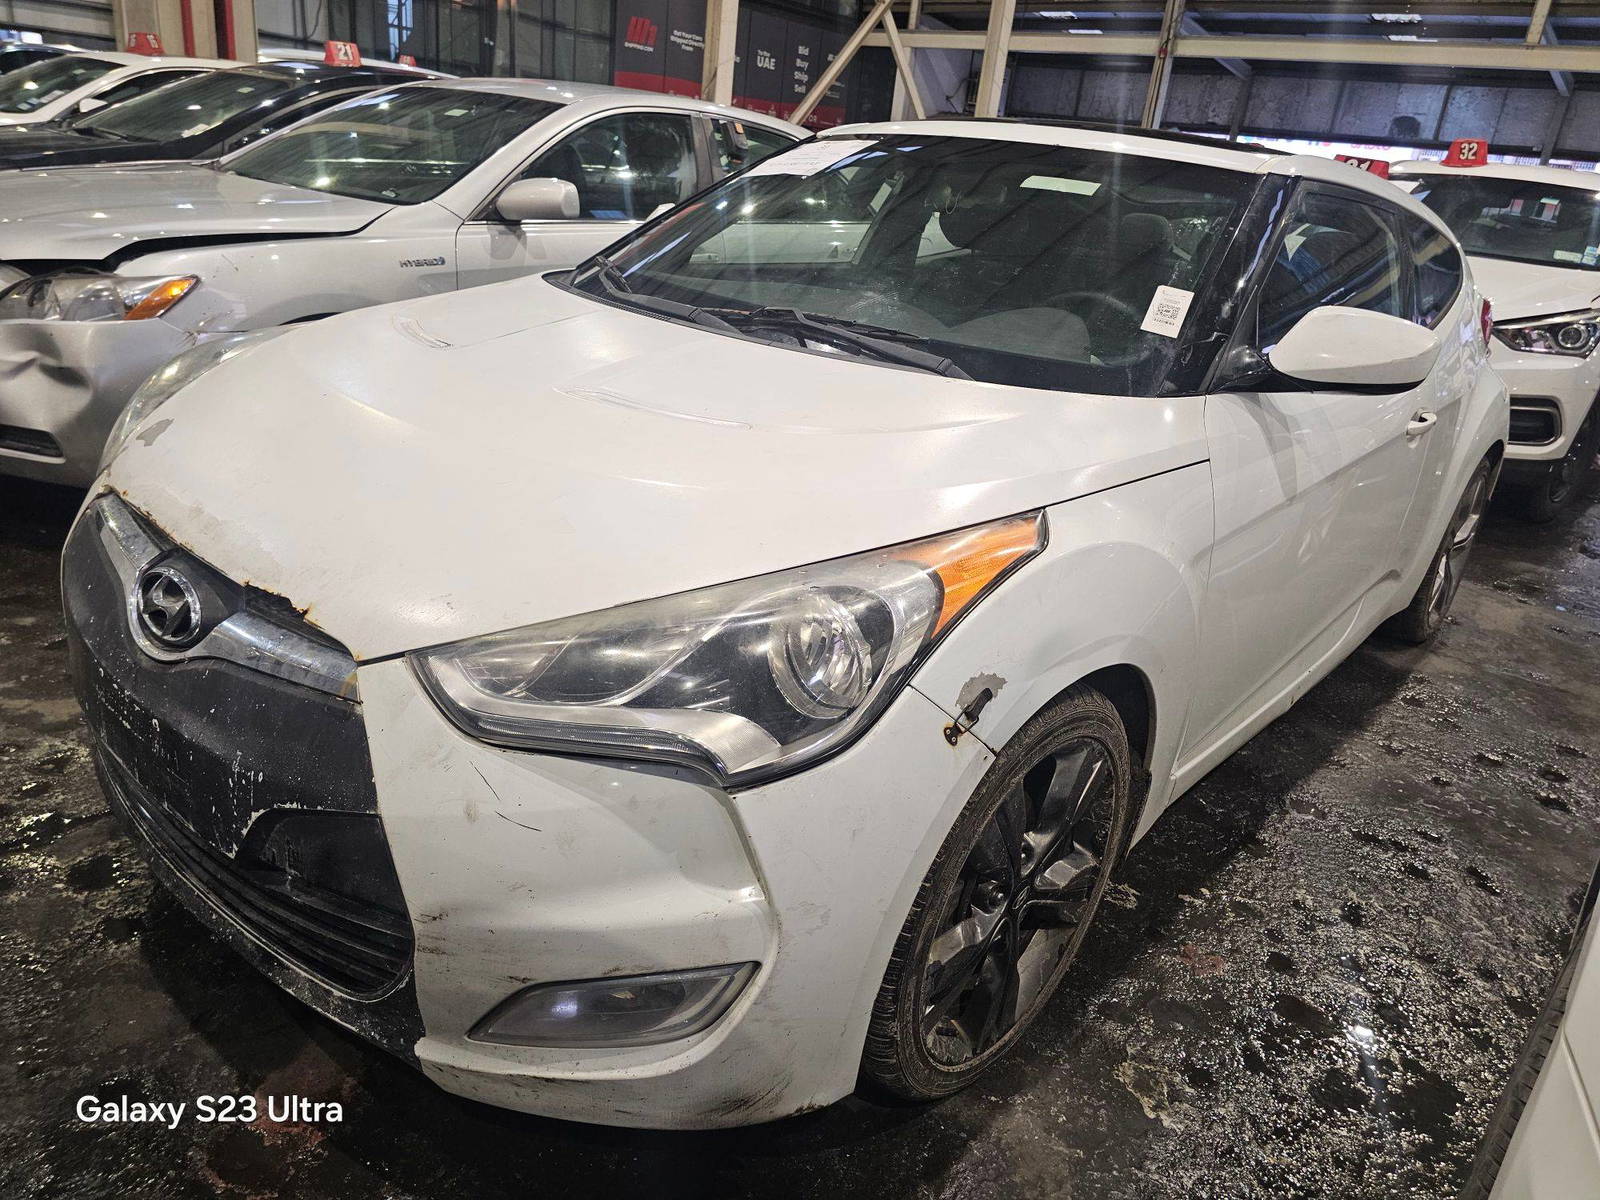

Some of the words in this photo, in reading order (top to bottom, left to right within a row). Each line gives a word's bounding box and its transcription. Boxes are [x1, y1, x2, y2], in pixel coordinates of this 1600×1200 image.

[337, 44, 353, 61] 21
[798, 45, 809, 56] Bid
[757, 56, 776, 70] UAE
[796, 58, 809, 71] Buy
[794, 71, 808, 83] Ship
[1459, 142, 1478, 160] 32
[399, 258, 438, 267] HYBRID
